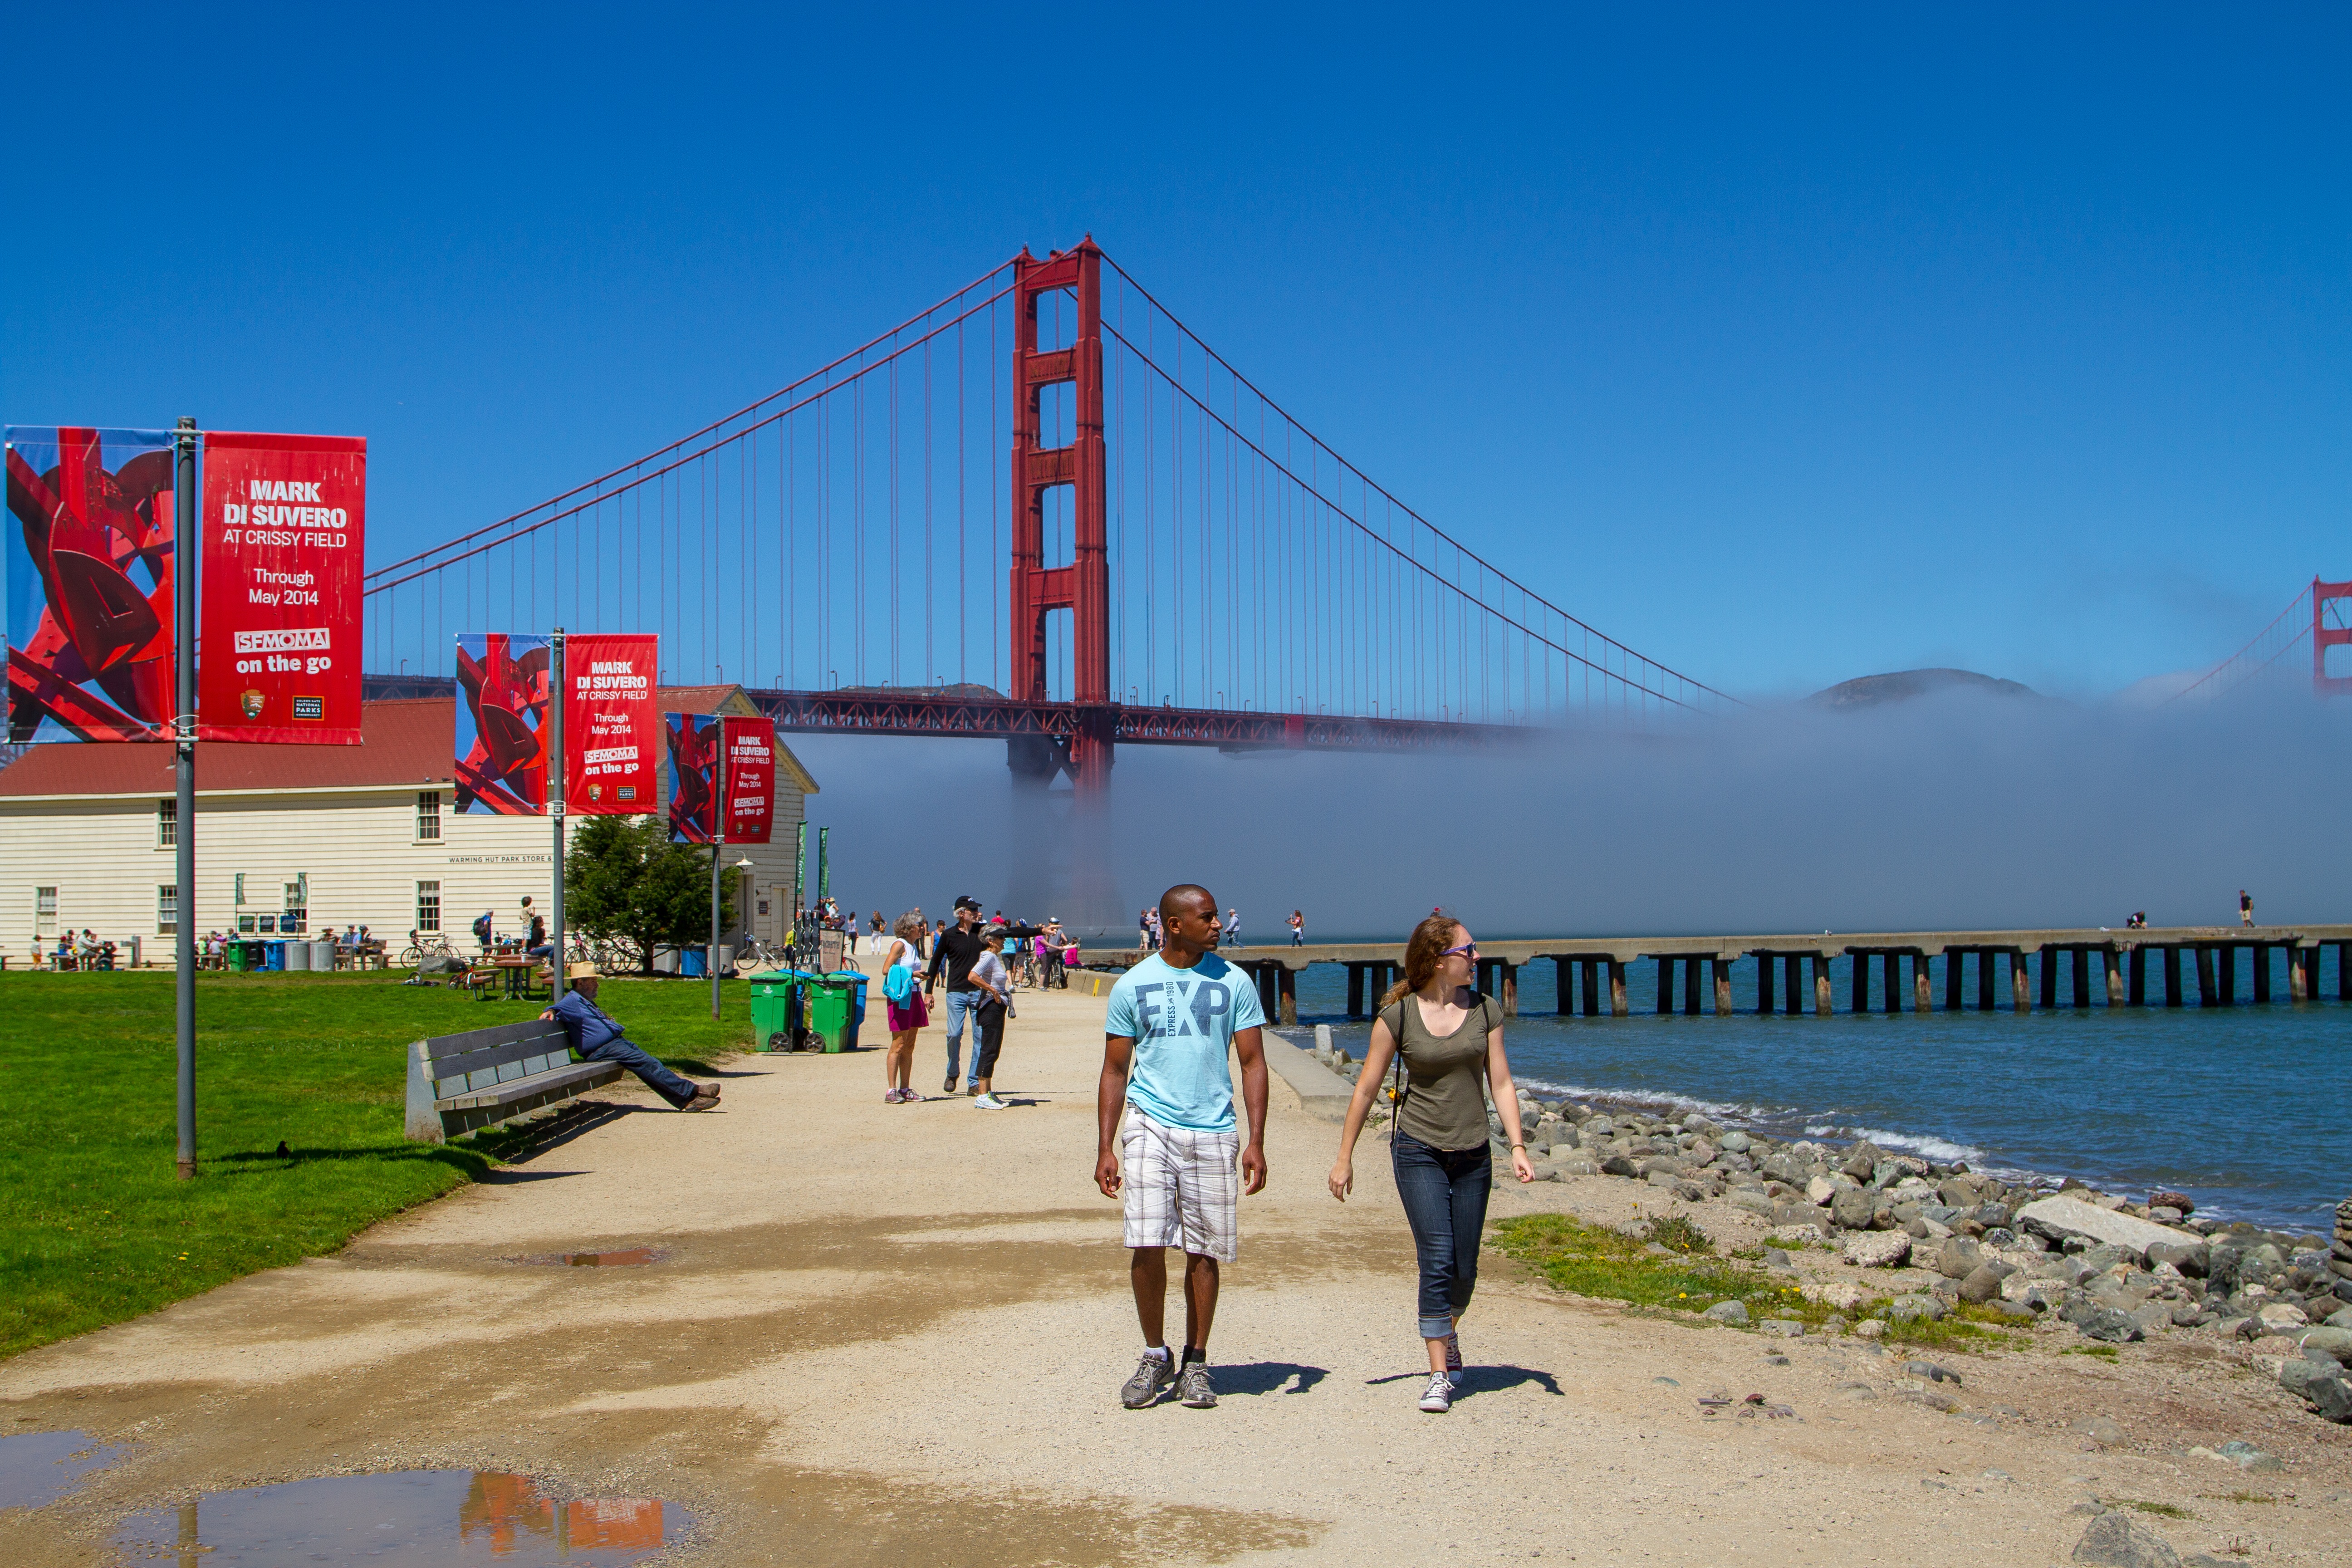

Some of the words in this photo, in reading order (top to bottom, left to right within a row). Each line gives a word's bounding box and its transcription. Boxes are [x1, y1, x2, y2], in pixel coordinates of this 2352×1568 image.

[250, 480, 321, 502] MARK
[224, 504, 247, 524] DI
[252, 506, 347, 528] SUVERO
[223, 529, 243, 543] AT
[245, 530, 301, 545] CRISSY
[304, 532, 347, 548] FIELD
[253, 568, 314, 587] Through
[249, 588, 280, 607] May
[284, 590, 319, 605] 2014
[237, 630, 328, 652] SFMOMA
[236, 660, 262, 673] on
[267, 654, 302, 672] the
[306, 657, 332, 674] go
[592, 662, 632, 674] MARK
[577, 676, 591, 689] DI
[593, 676, 647, 689] SUVERO
[577, 691, 588, 700] AT
[589, 691, 621, 700] CRISSY
[622, 691, 647, 700] FIELD
[594, 713, 628, 723] Through
[592, 725, 609, 735] May
[611, 725, 632, 734] 2014
[738, 736, 761, 745] MARK
[586, 748, 637, 762] SFMOMA
[731, 746, 739, 755] DI
[740, 747, 769, 756] SUVERO
[585, 766, 600, 775] on
[602, 763, 622, 774] the
[624, 763, 639, 774] go
[740, 772, 760, 780] Through
[735, 798, 764, 807] SFMOMA
[744, 807, 755, 815] the
[756, 808, 764, 816] go
[1166, 981, 1174, 997] 1980
[1135, 981, 1230, 1038] EXP
[1167, 1006, 1176, 1037] EXPRESS
